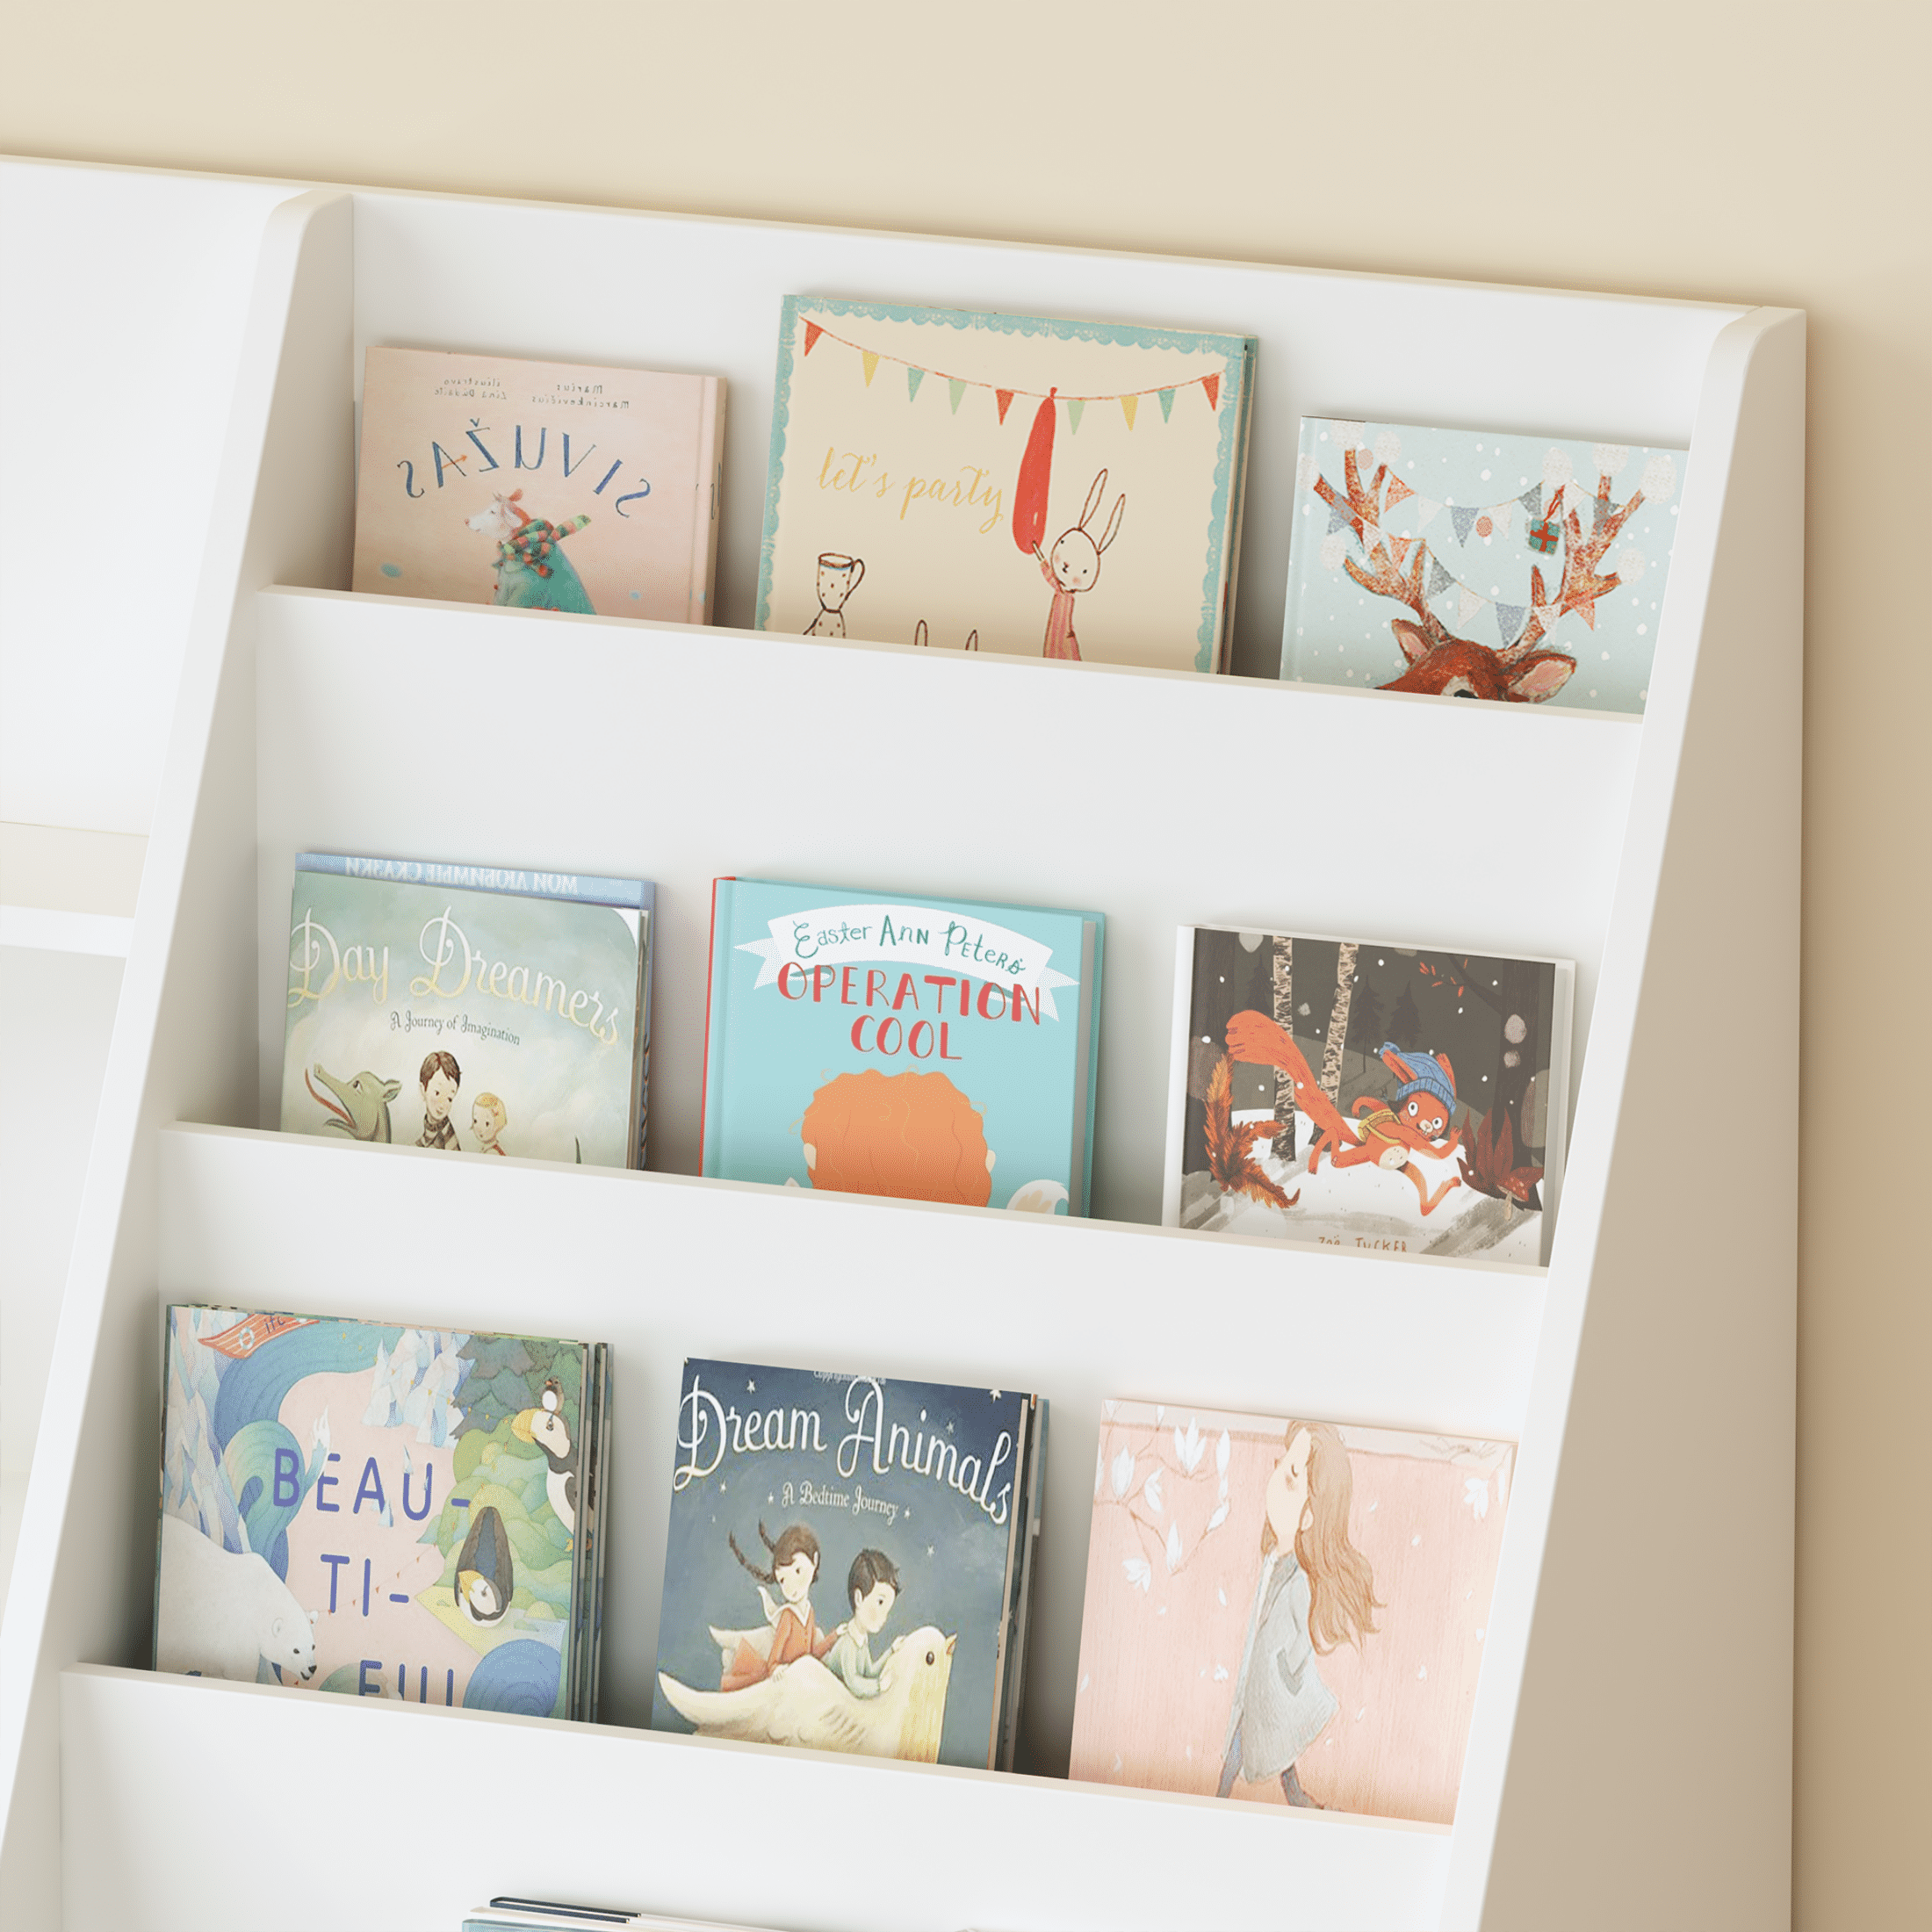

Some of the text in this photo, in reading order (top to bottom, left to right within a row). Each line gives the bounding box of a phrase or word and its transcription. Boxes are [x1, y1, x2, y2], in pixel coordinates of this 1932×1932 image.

[817, 446, 1004, 534] let's party
[792, 920, 872, 958] Easter
[288, 905, 618, 1045] Day Dreamers
[777, 962, 1040, 1026] OPERATION
[390, 1010, 520, 1046] A Journey of Imagination
[851, 1014, 962, 1060] COOL
[674, 1374, 1012, 1525] Dream Animals
[273, 1447, 470, 1522] BEAU-
[781, 1480, 898, 1526] A Bedtime Journey
[320, 1554, 409, 1618] TI-
